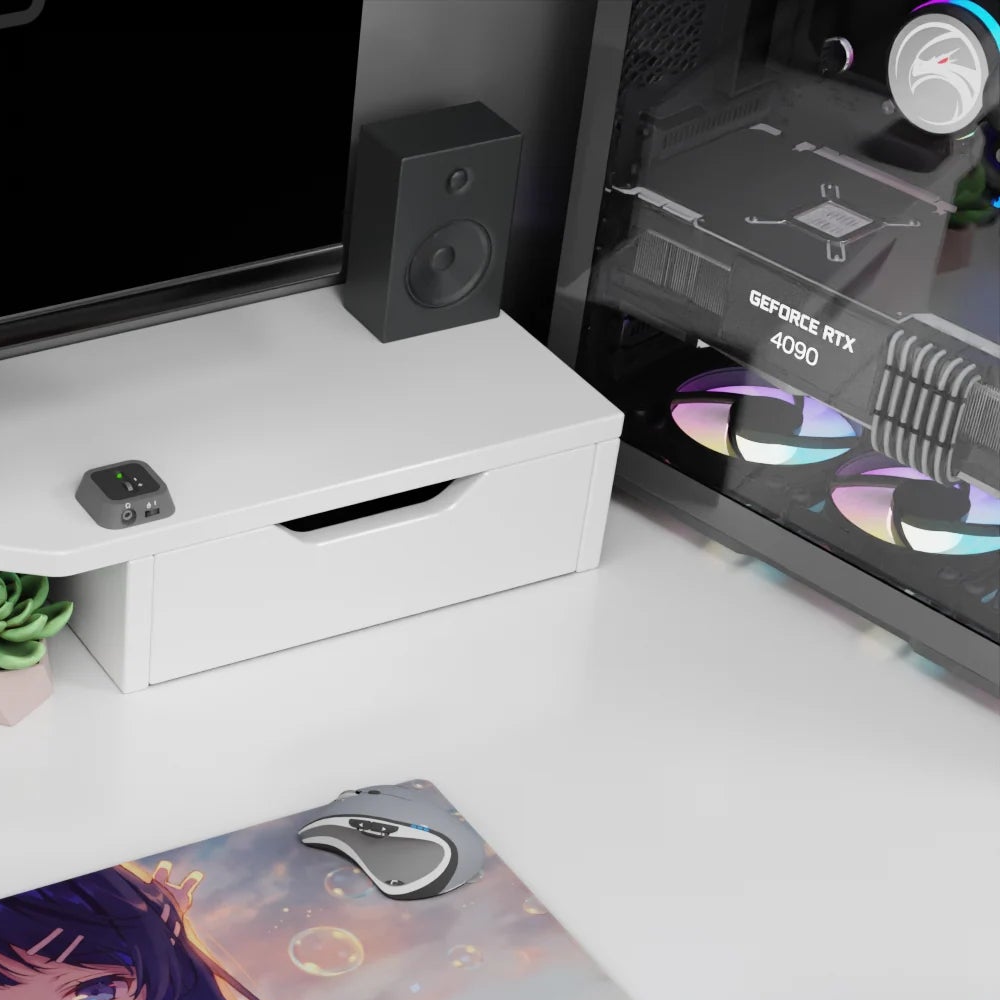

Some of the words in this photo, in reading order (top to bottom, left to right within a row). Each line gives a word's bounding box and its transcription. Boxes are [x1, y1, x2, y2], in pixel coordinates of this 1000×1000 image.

[749, 289, 821, 336] GEFORCE
[822, 324, 856, 354] RTX
[769, 331, 819, 367] 4090
